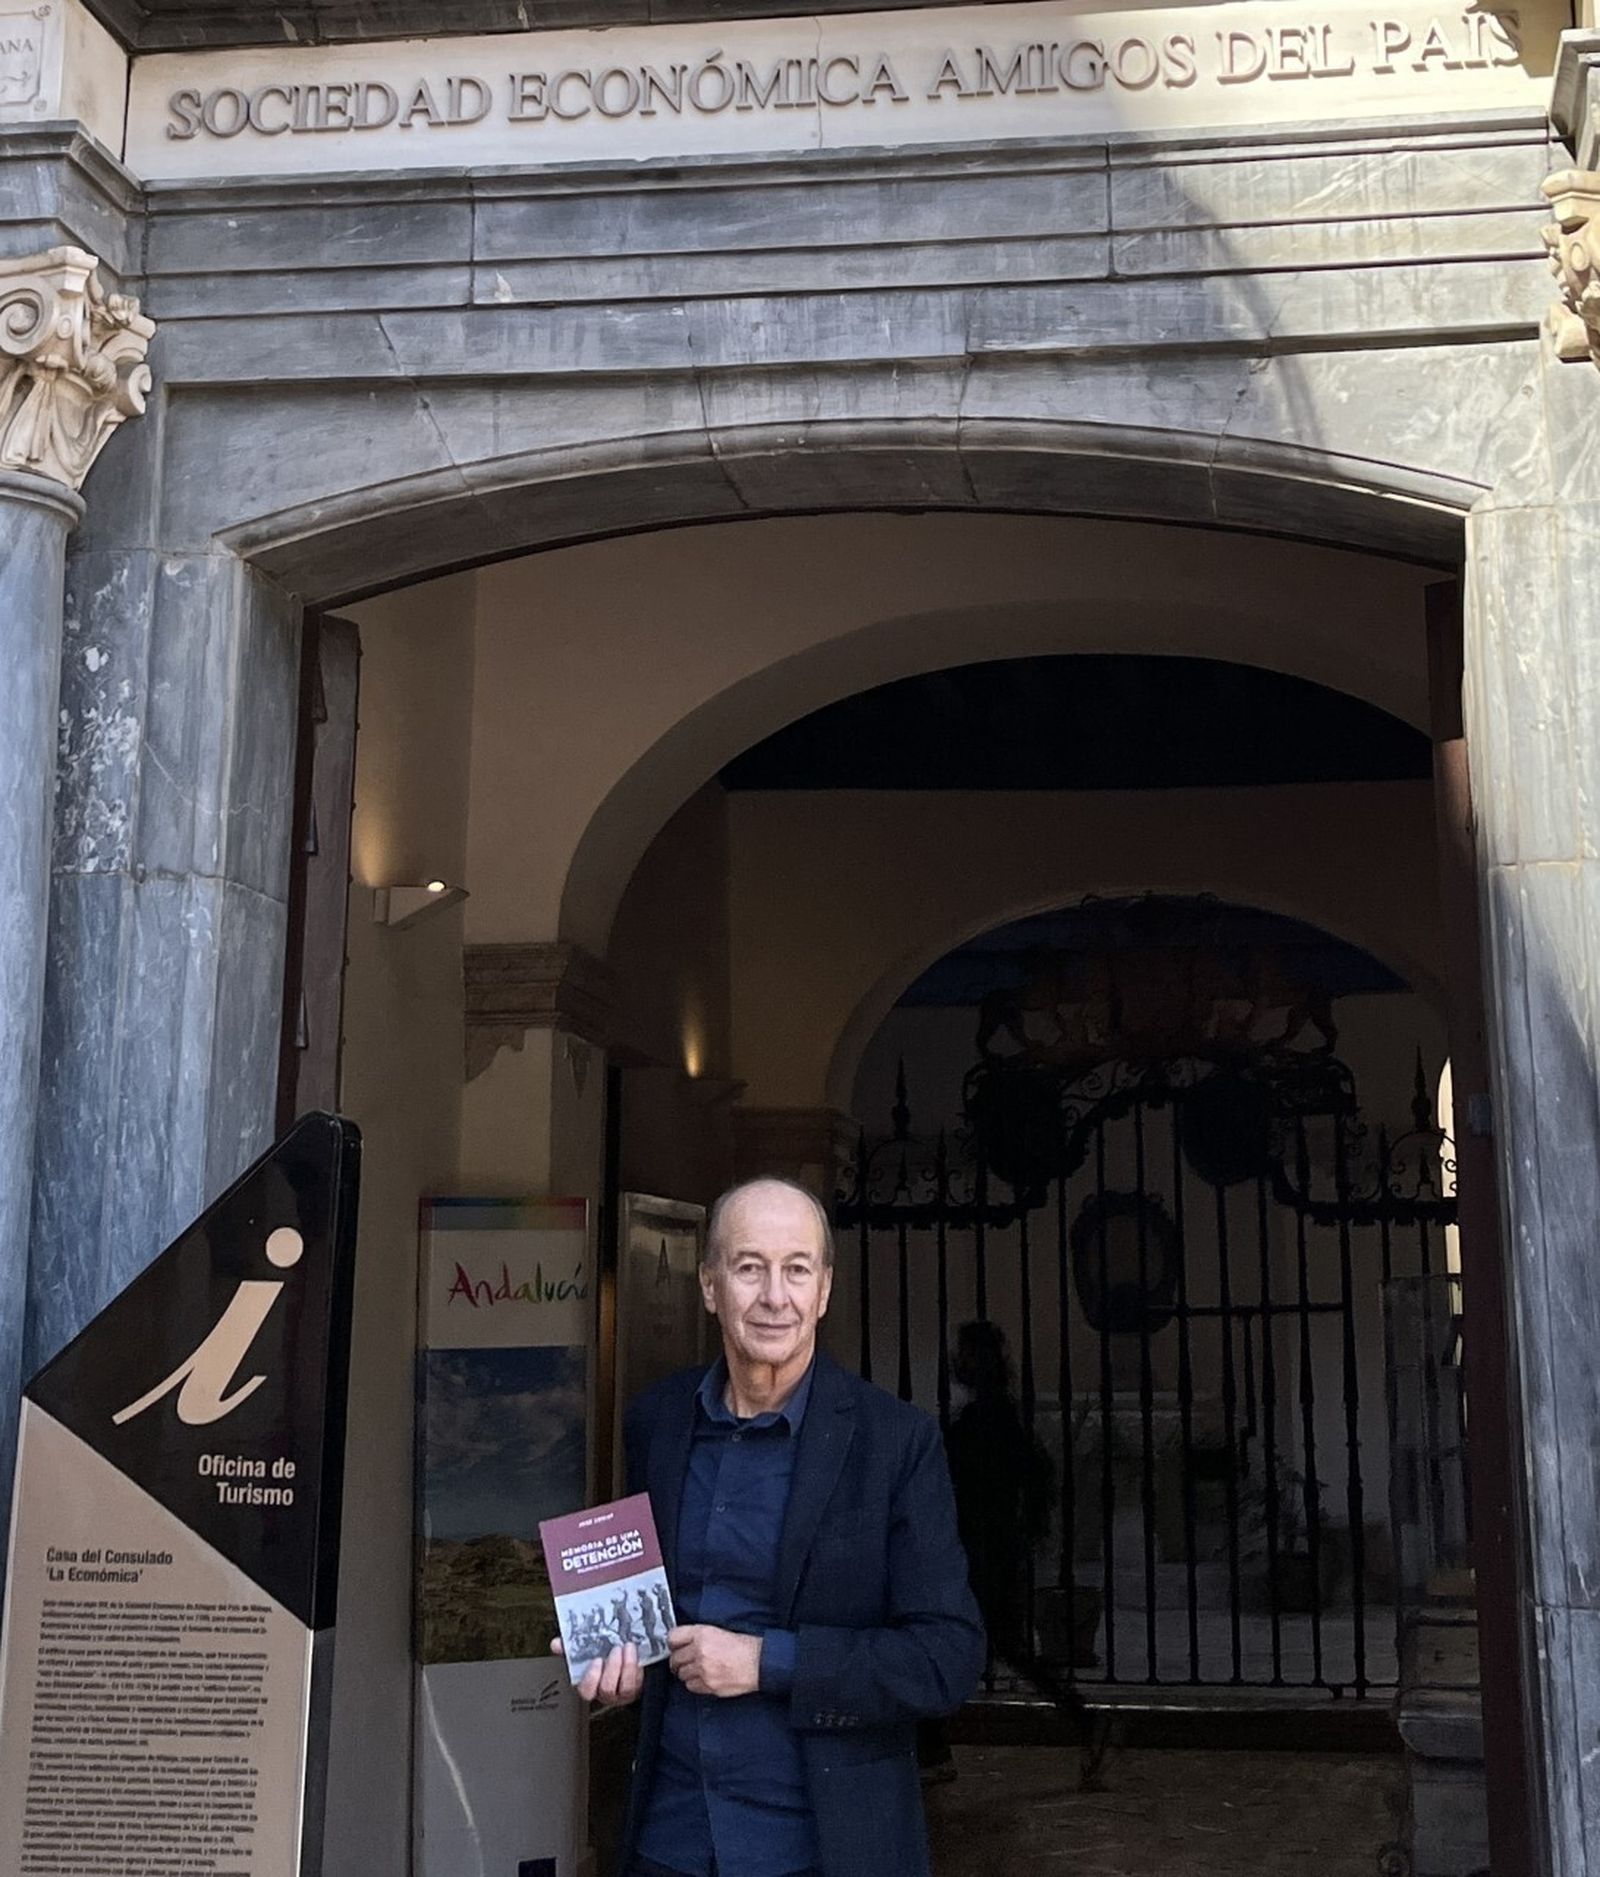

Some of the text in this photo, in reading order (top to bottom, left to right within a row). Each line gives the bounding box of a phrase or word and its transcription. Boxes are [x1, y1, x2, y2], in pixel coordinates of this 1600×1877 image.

[167, 4, 1525, 140] SOCIEDAD ECONÓMICA AMIGOS DEL PAÍS
[198, 1454, 296, 1479] Oficina de
[216, 1481, 294, 1506] Turismo
[46, 1547, 173, 1565] Casa del Consulado
[561, 1540, 603, 1557] MEMORIA
[605, 1535, 618, 1545] DE
[562, 1538, 643, 1571] DETENCIÓN
[46, 1567, 143, 1583] 'La Económica'
